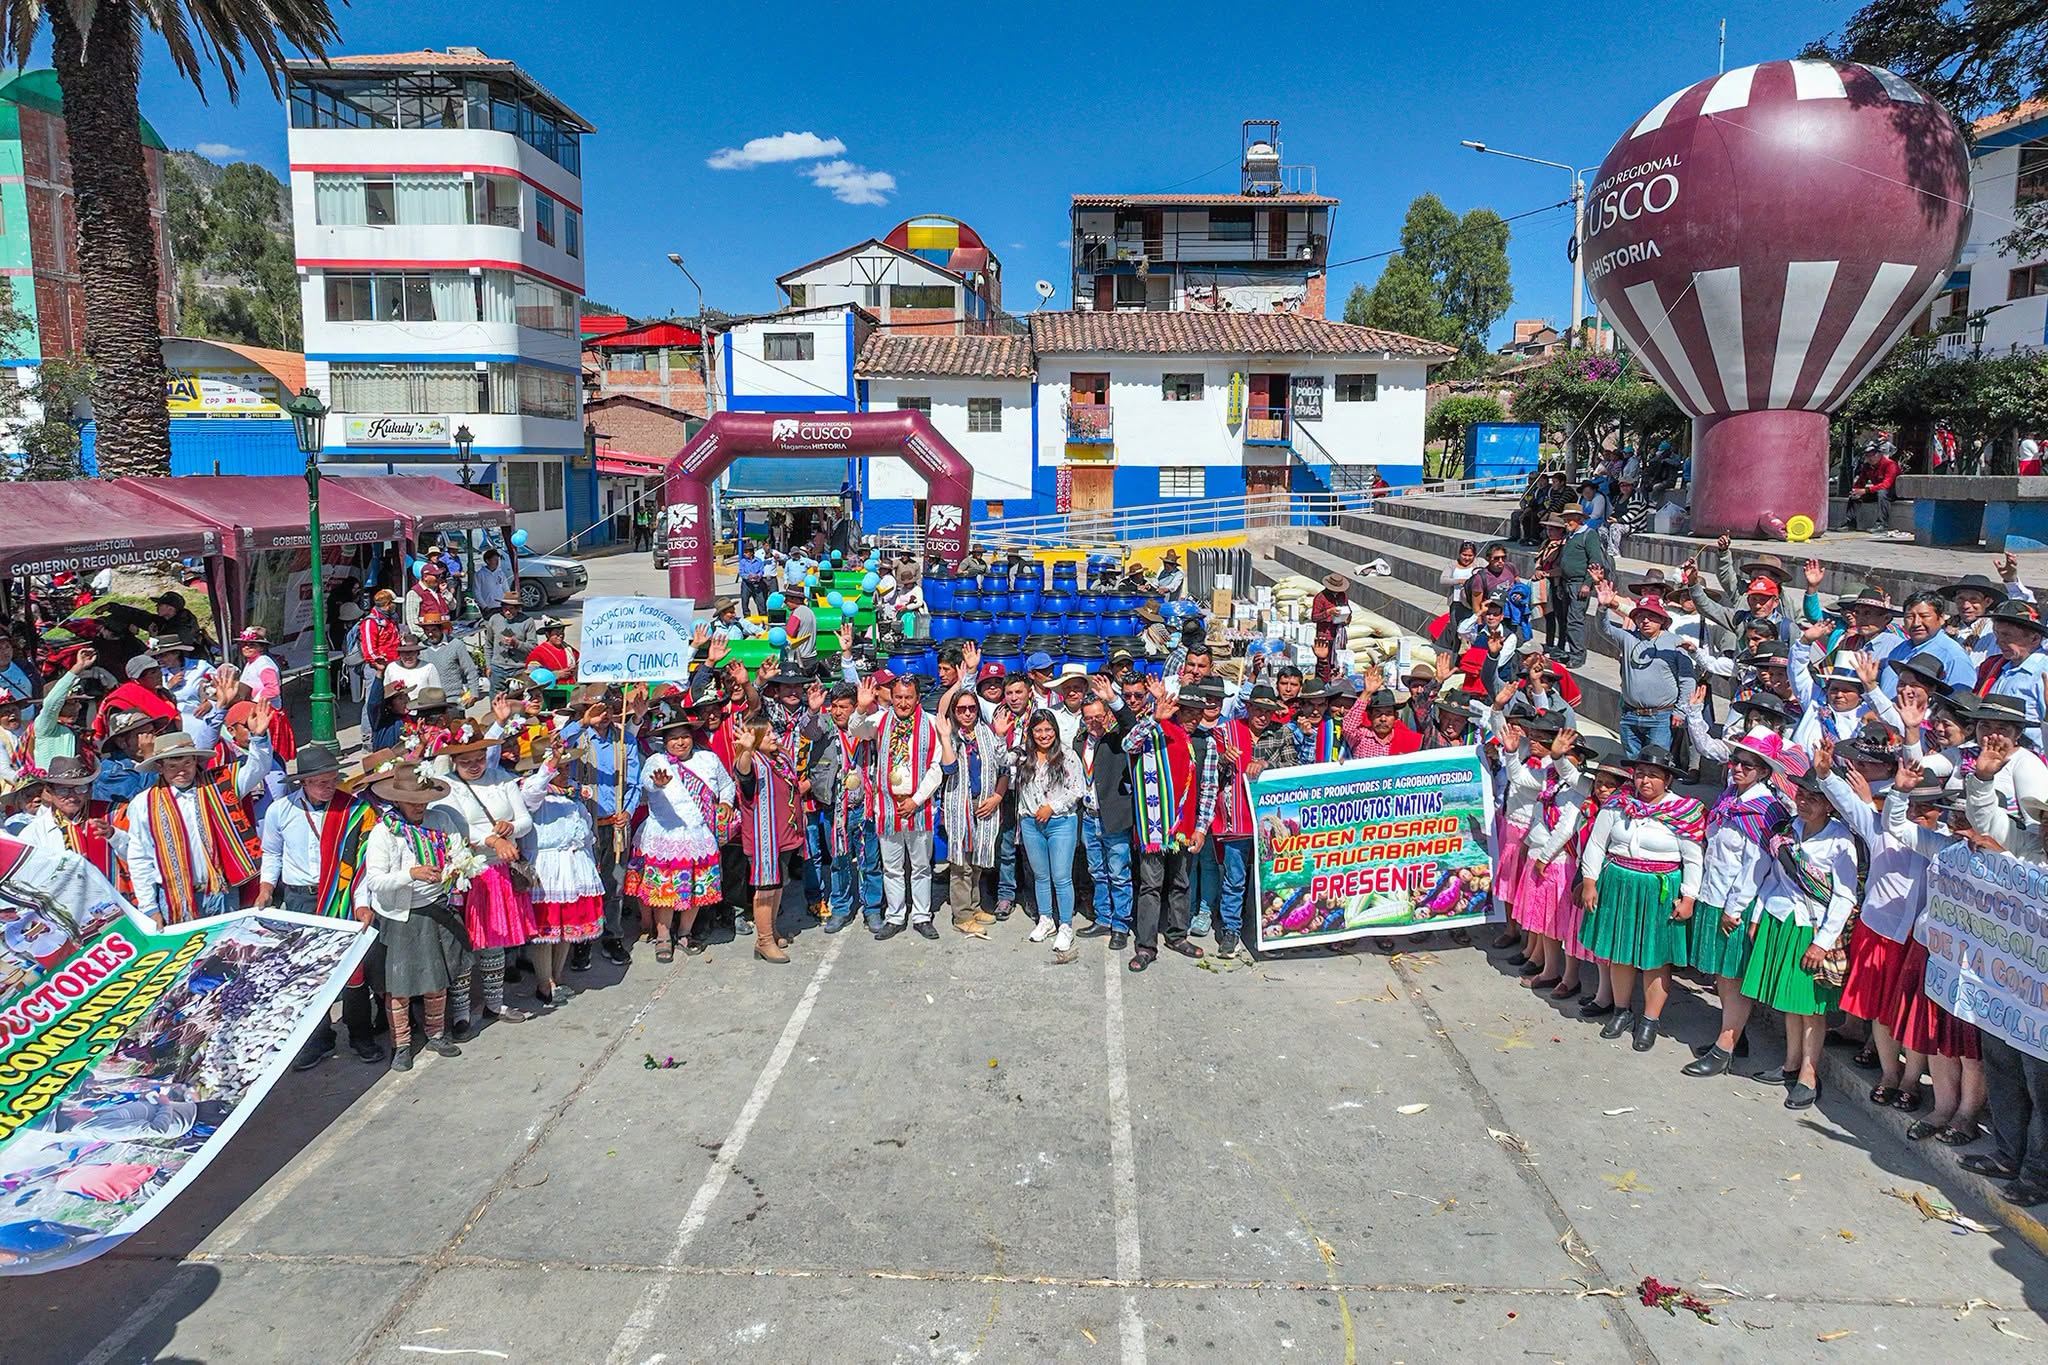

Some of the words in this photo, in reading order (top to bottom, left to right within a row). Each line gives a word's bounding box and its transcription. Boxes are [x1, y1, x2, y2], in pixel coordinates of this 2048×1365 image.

[1616, 153, 1682, 185] REGIONAL
[1296, 387, 1322, 397] POLLO
[1297, 396, 1304, 405] A
[1308, 396, 1320, 405] LA
[1295, 405, 1321, 416] BRASA
[368, 418, 424, 438] Kukuly's
[801, 427, 852, 440] CUSCO
[321, 533, 352, 543] EGIONAL
[355, 531, 378, 540] CUSCO
[667, 540, 698, 550] CUSCO
[926, 541, 960, 551] CUSCO
[11, 559, 79, 576] GOBIERNO
[82, 551, 141, 568] REGIONAL
[144, 548, 180, 561] CUSCO
[584, 607, 635, 636] ASOCIACION
[592, 635, 613, 648] INTI
[627, 652, 679, 673] CHANCA
[1259, 787, 1310, 806] ASOCIACIÓN
[1311, 788, 1322, 800] DE
[1324, 780, 1381, 798] PRODUCTORES
[1382, 778, 1392, 790] DE
[1394, 771, 1473, 788] AGROBIODIVERSIDAD
[1301, 806, 1317, 828] DE
[1321, 799, 1390, 827] PRODUCTOS
[1394, 791, 1444, 817] NATIVAS
[1272, 829, 1355, 854] VIRGEN
[1362, 817, 1459, 842] ROSARIO
[1273, 855, 1304, 874] DE
[1312, 837, 1463, 869] TAUCABAMBA
[1311, 863, 1438, 902] PRESENTE
[1929, 926, 1952, 961] DE
[1959, 940, 1985, 978] LA
[1924, 959, 1947, 996] DE
[0, 949, 172, 1086] COMUNIDAD
[0, 1058, 90, 1140] LCHA
